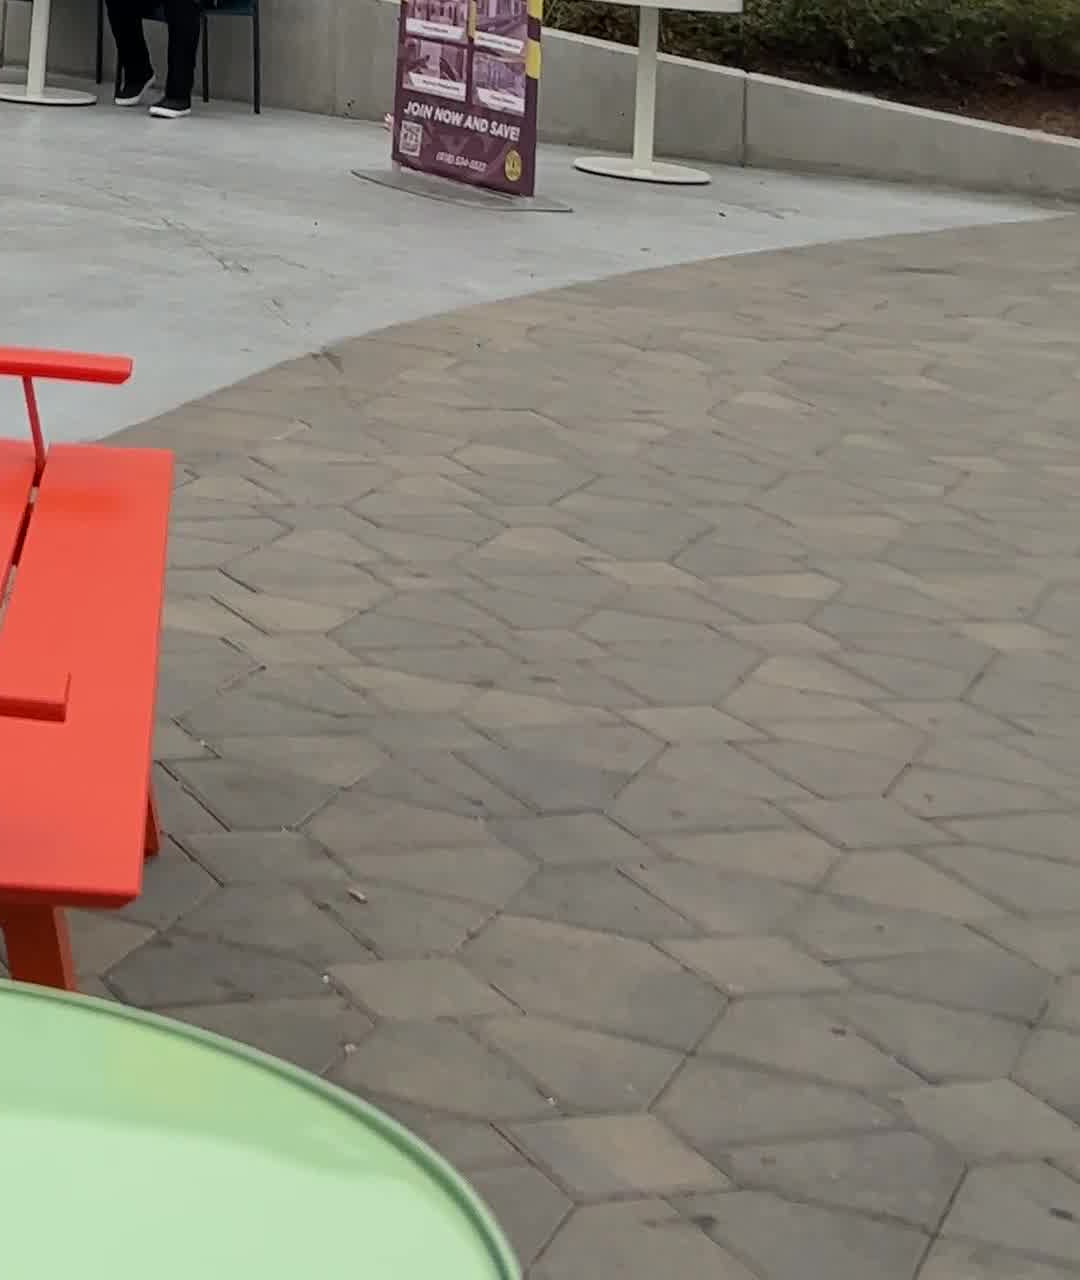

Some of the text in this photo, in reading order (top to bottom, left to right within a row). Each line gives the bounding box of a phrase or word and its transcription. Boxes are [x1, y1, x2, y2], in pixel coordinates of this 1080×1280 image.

[403, 101, 521, 142] JOIN NOW AND SAVE!
